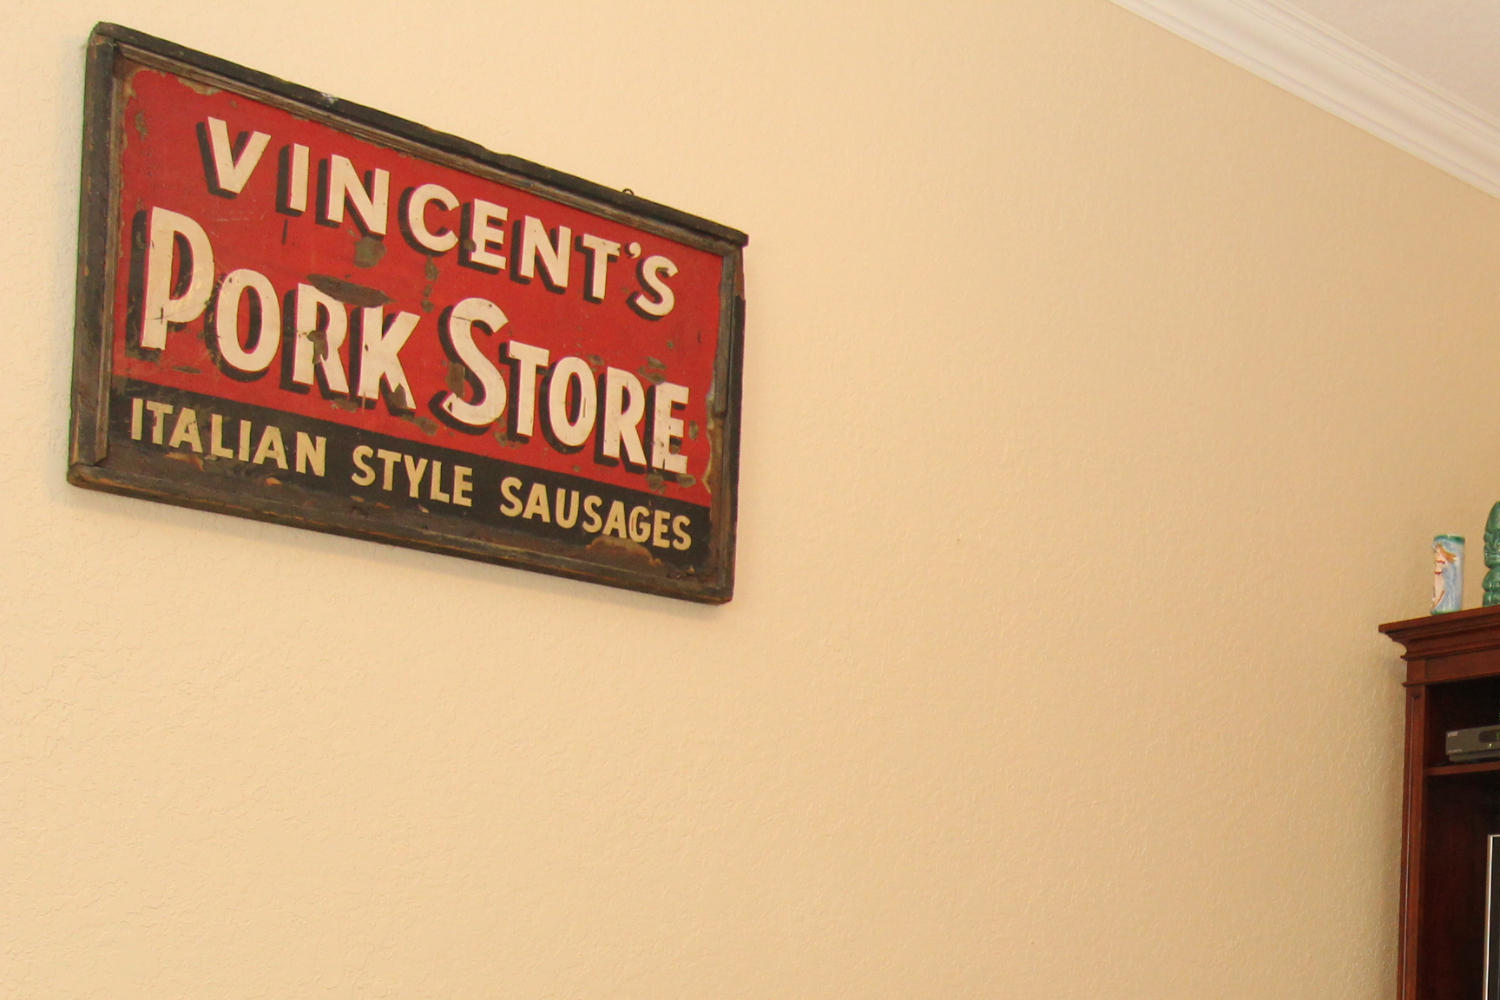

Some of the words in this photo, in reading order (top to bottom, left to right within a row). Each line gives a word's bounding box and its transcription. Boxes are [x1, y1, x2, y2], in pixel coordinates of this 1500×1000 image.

[206, 116, 680, 318] VINCENT'S
[140, 206, 421, 411] PORK
[442, 297, 690, 475] STORE
[131, 398, 328, 478] ITALIAN
[351, 445, 474, 507] STYLE
[500, 476, 692, 551] SAUSAGES
